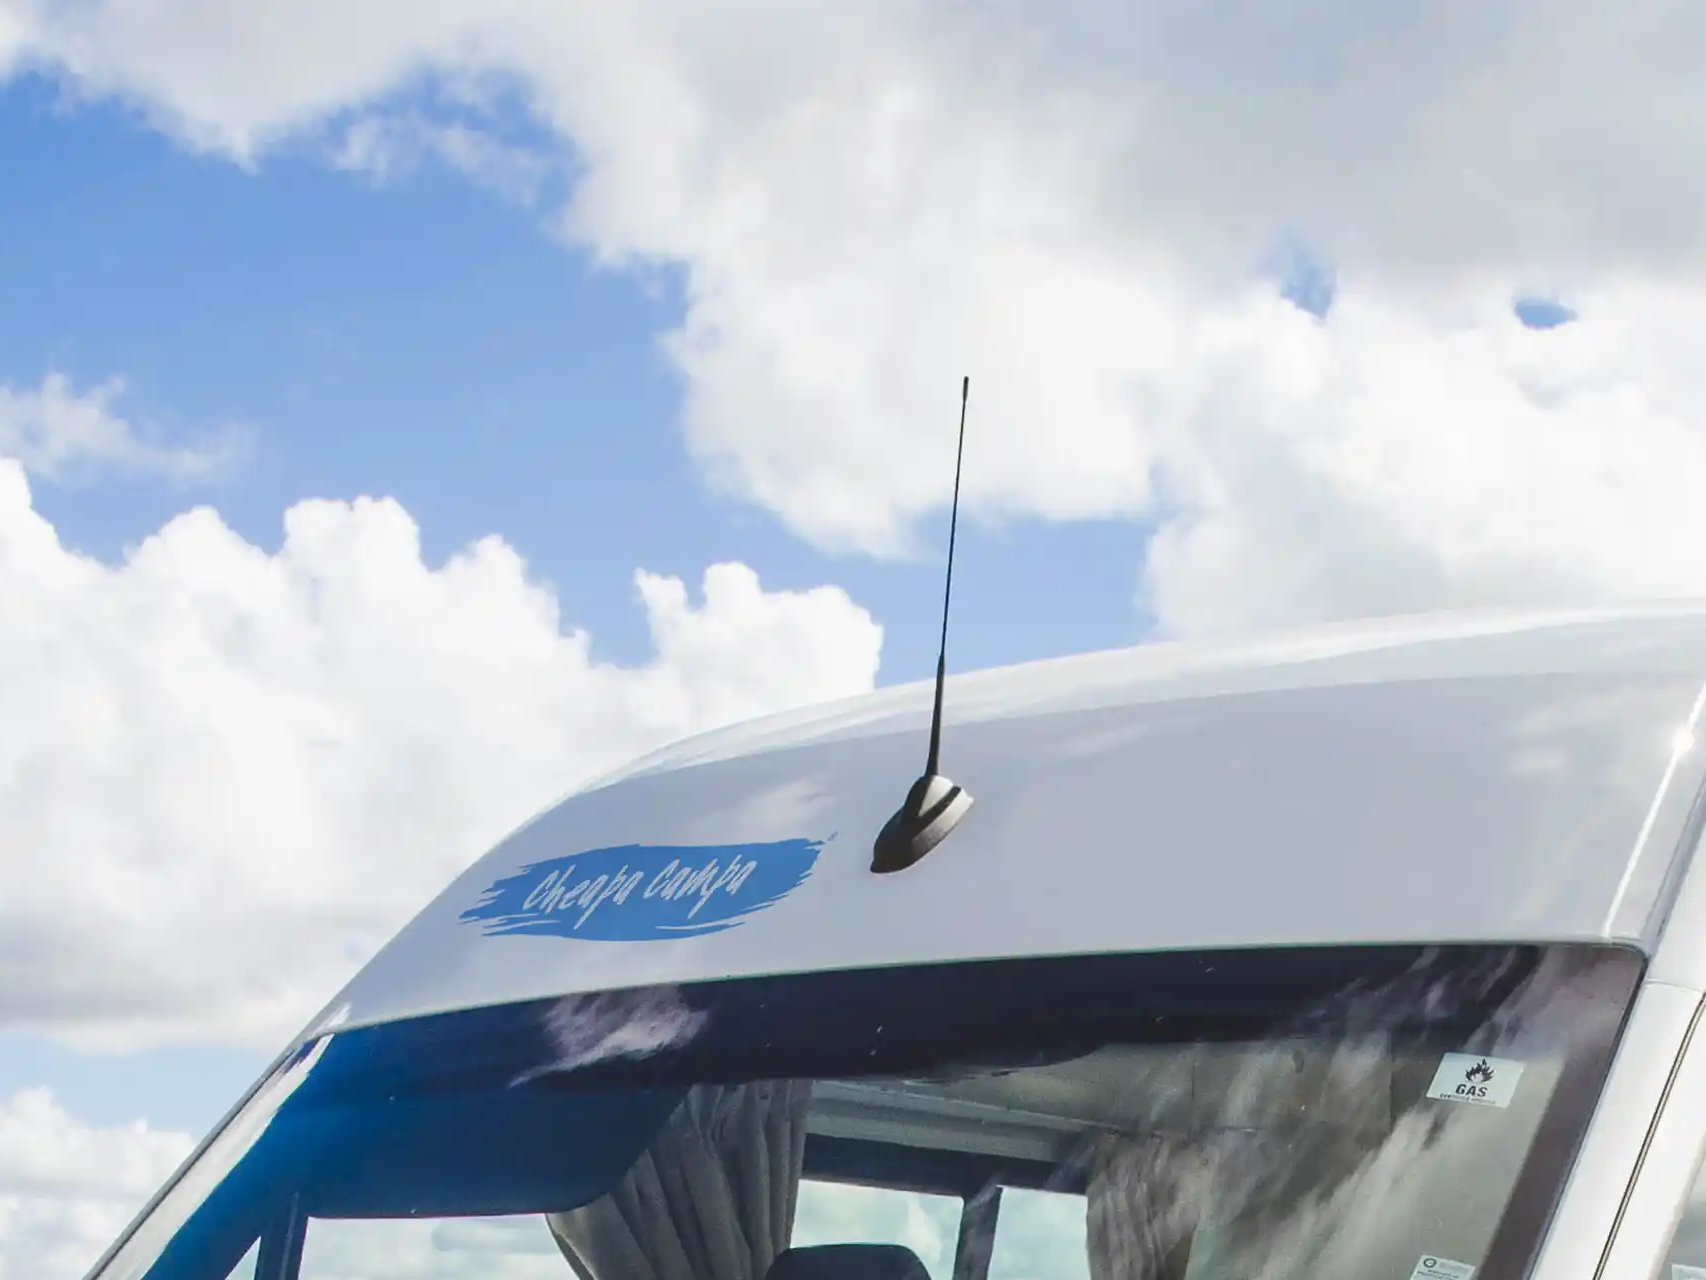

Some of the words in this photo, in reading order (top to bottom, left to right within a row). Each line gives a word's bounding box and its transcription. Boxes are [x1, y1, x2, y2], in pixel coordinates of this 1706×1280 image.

[522, 865, 644, 929] Cheapa
[644, 854, 757, 918] Campa
[1455, 1083, 1488, 1098] GAS
